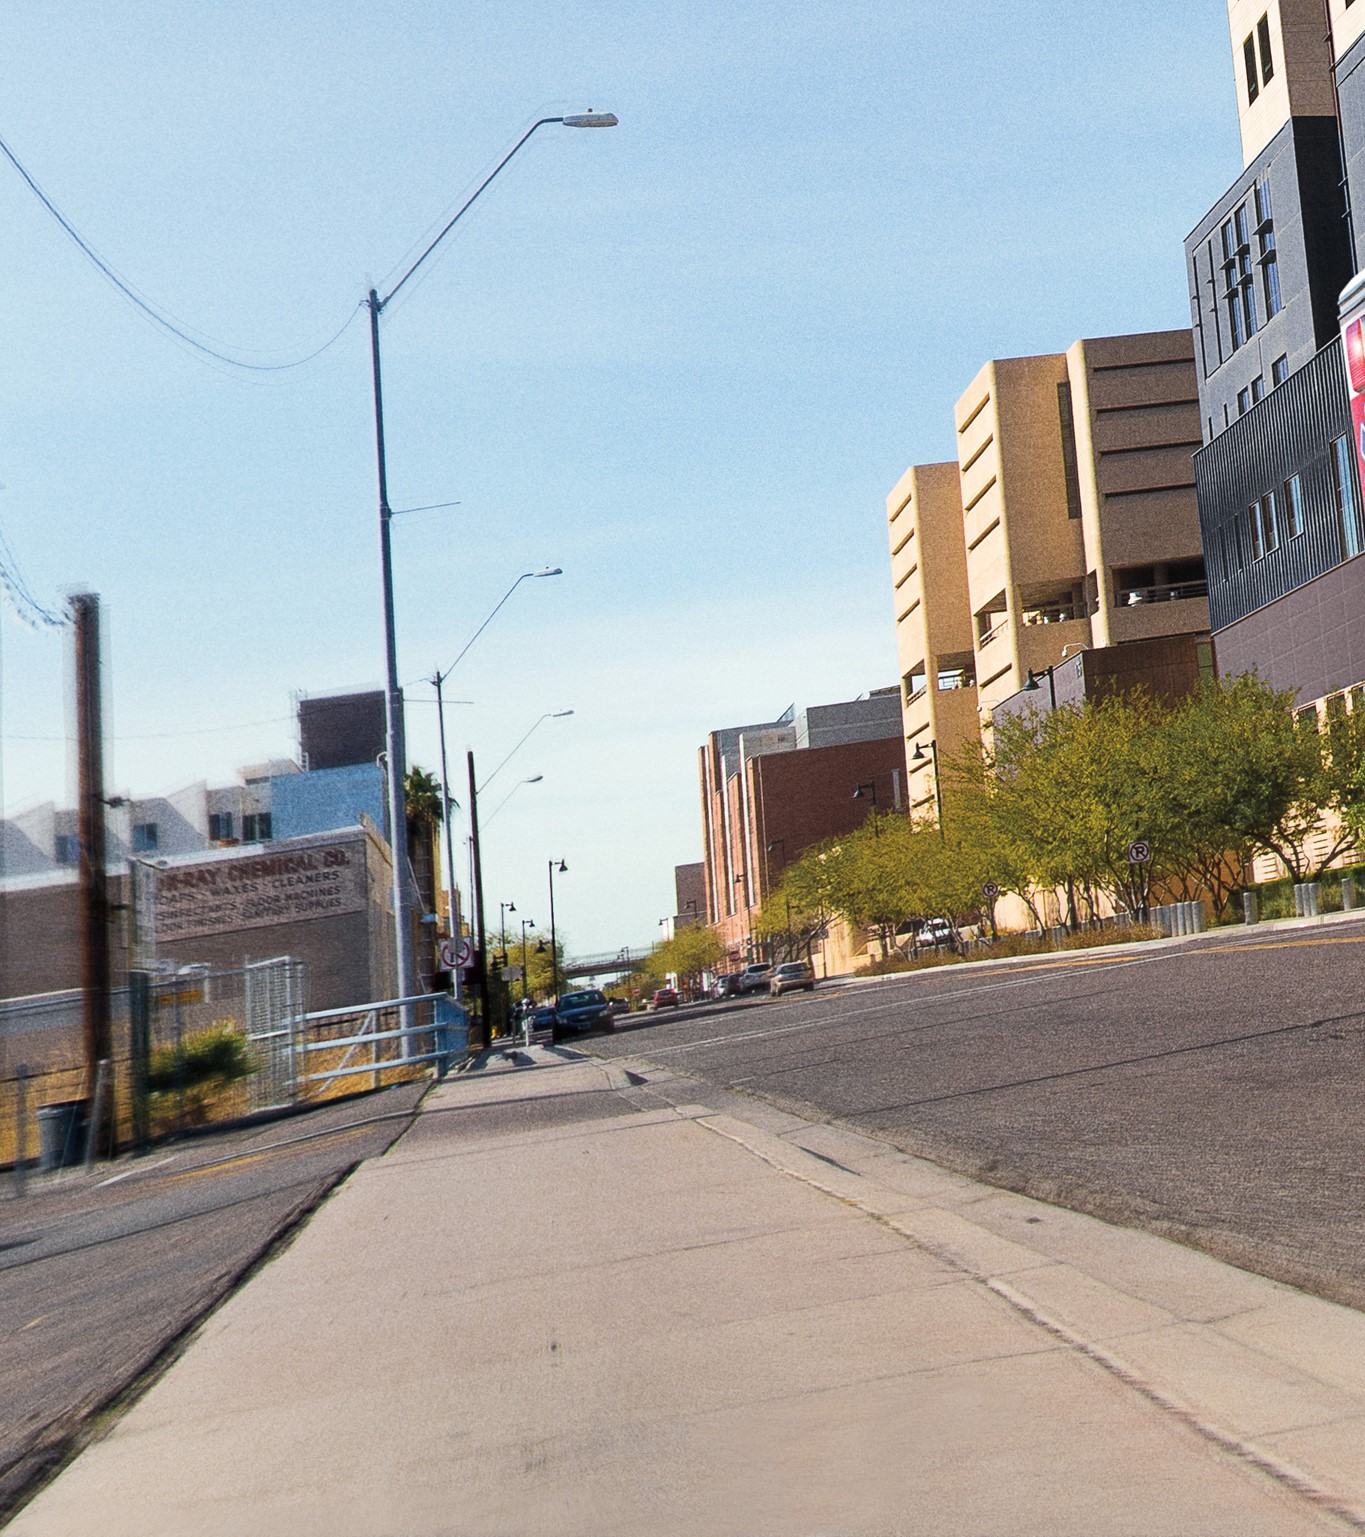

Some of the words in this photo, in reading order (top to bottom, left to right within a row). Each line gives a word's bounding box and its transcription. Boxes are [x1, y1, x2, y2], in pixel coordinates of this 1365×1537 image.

[227, 854, 319, 881] CHEMICAL
[272, 870, 340, 889] CLEANERS
[284, 886, 341, 902] MACHINES
[295, 897, 341, 913] SUPPLIES
